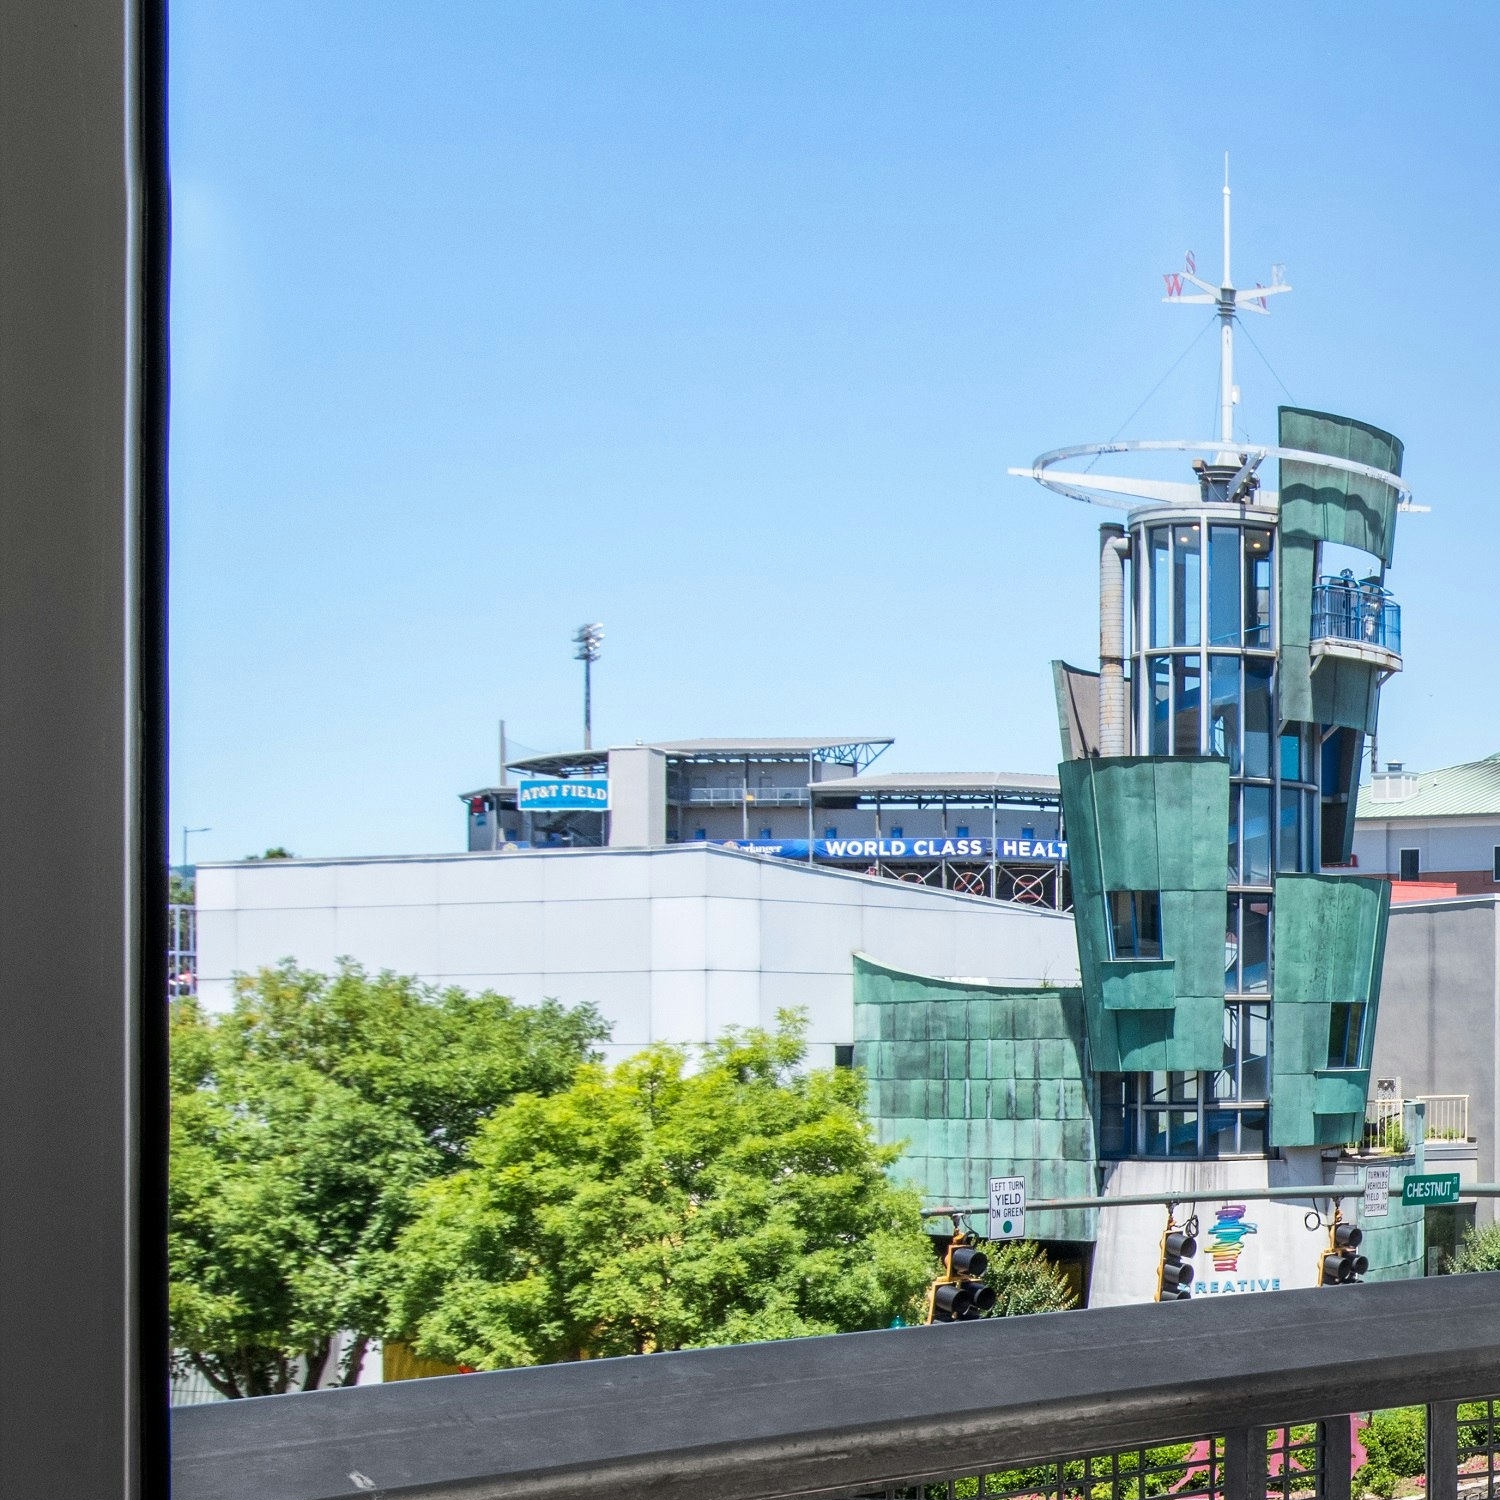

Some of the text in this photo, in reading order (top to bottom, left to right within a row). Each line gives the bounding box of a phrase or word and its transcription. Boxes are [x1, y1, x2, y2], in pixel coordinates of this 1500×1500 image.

[521, 784, 607, 801] AT&T FIELD
[825, 839, 1068, 858] WORLD CLASS HEALT
[992, 1181, 1023, 1192] LEFT TURN
[1406, 1181, 1452, 1198] CHESTNUT
[995, 1193, 1021, 1205] YIELD
[1365, 1192, 1379, 1201] YIELD
[992, 1207, 1023, 1218] ON GREEN
